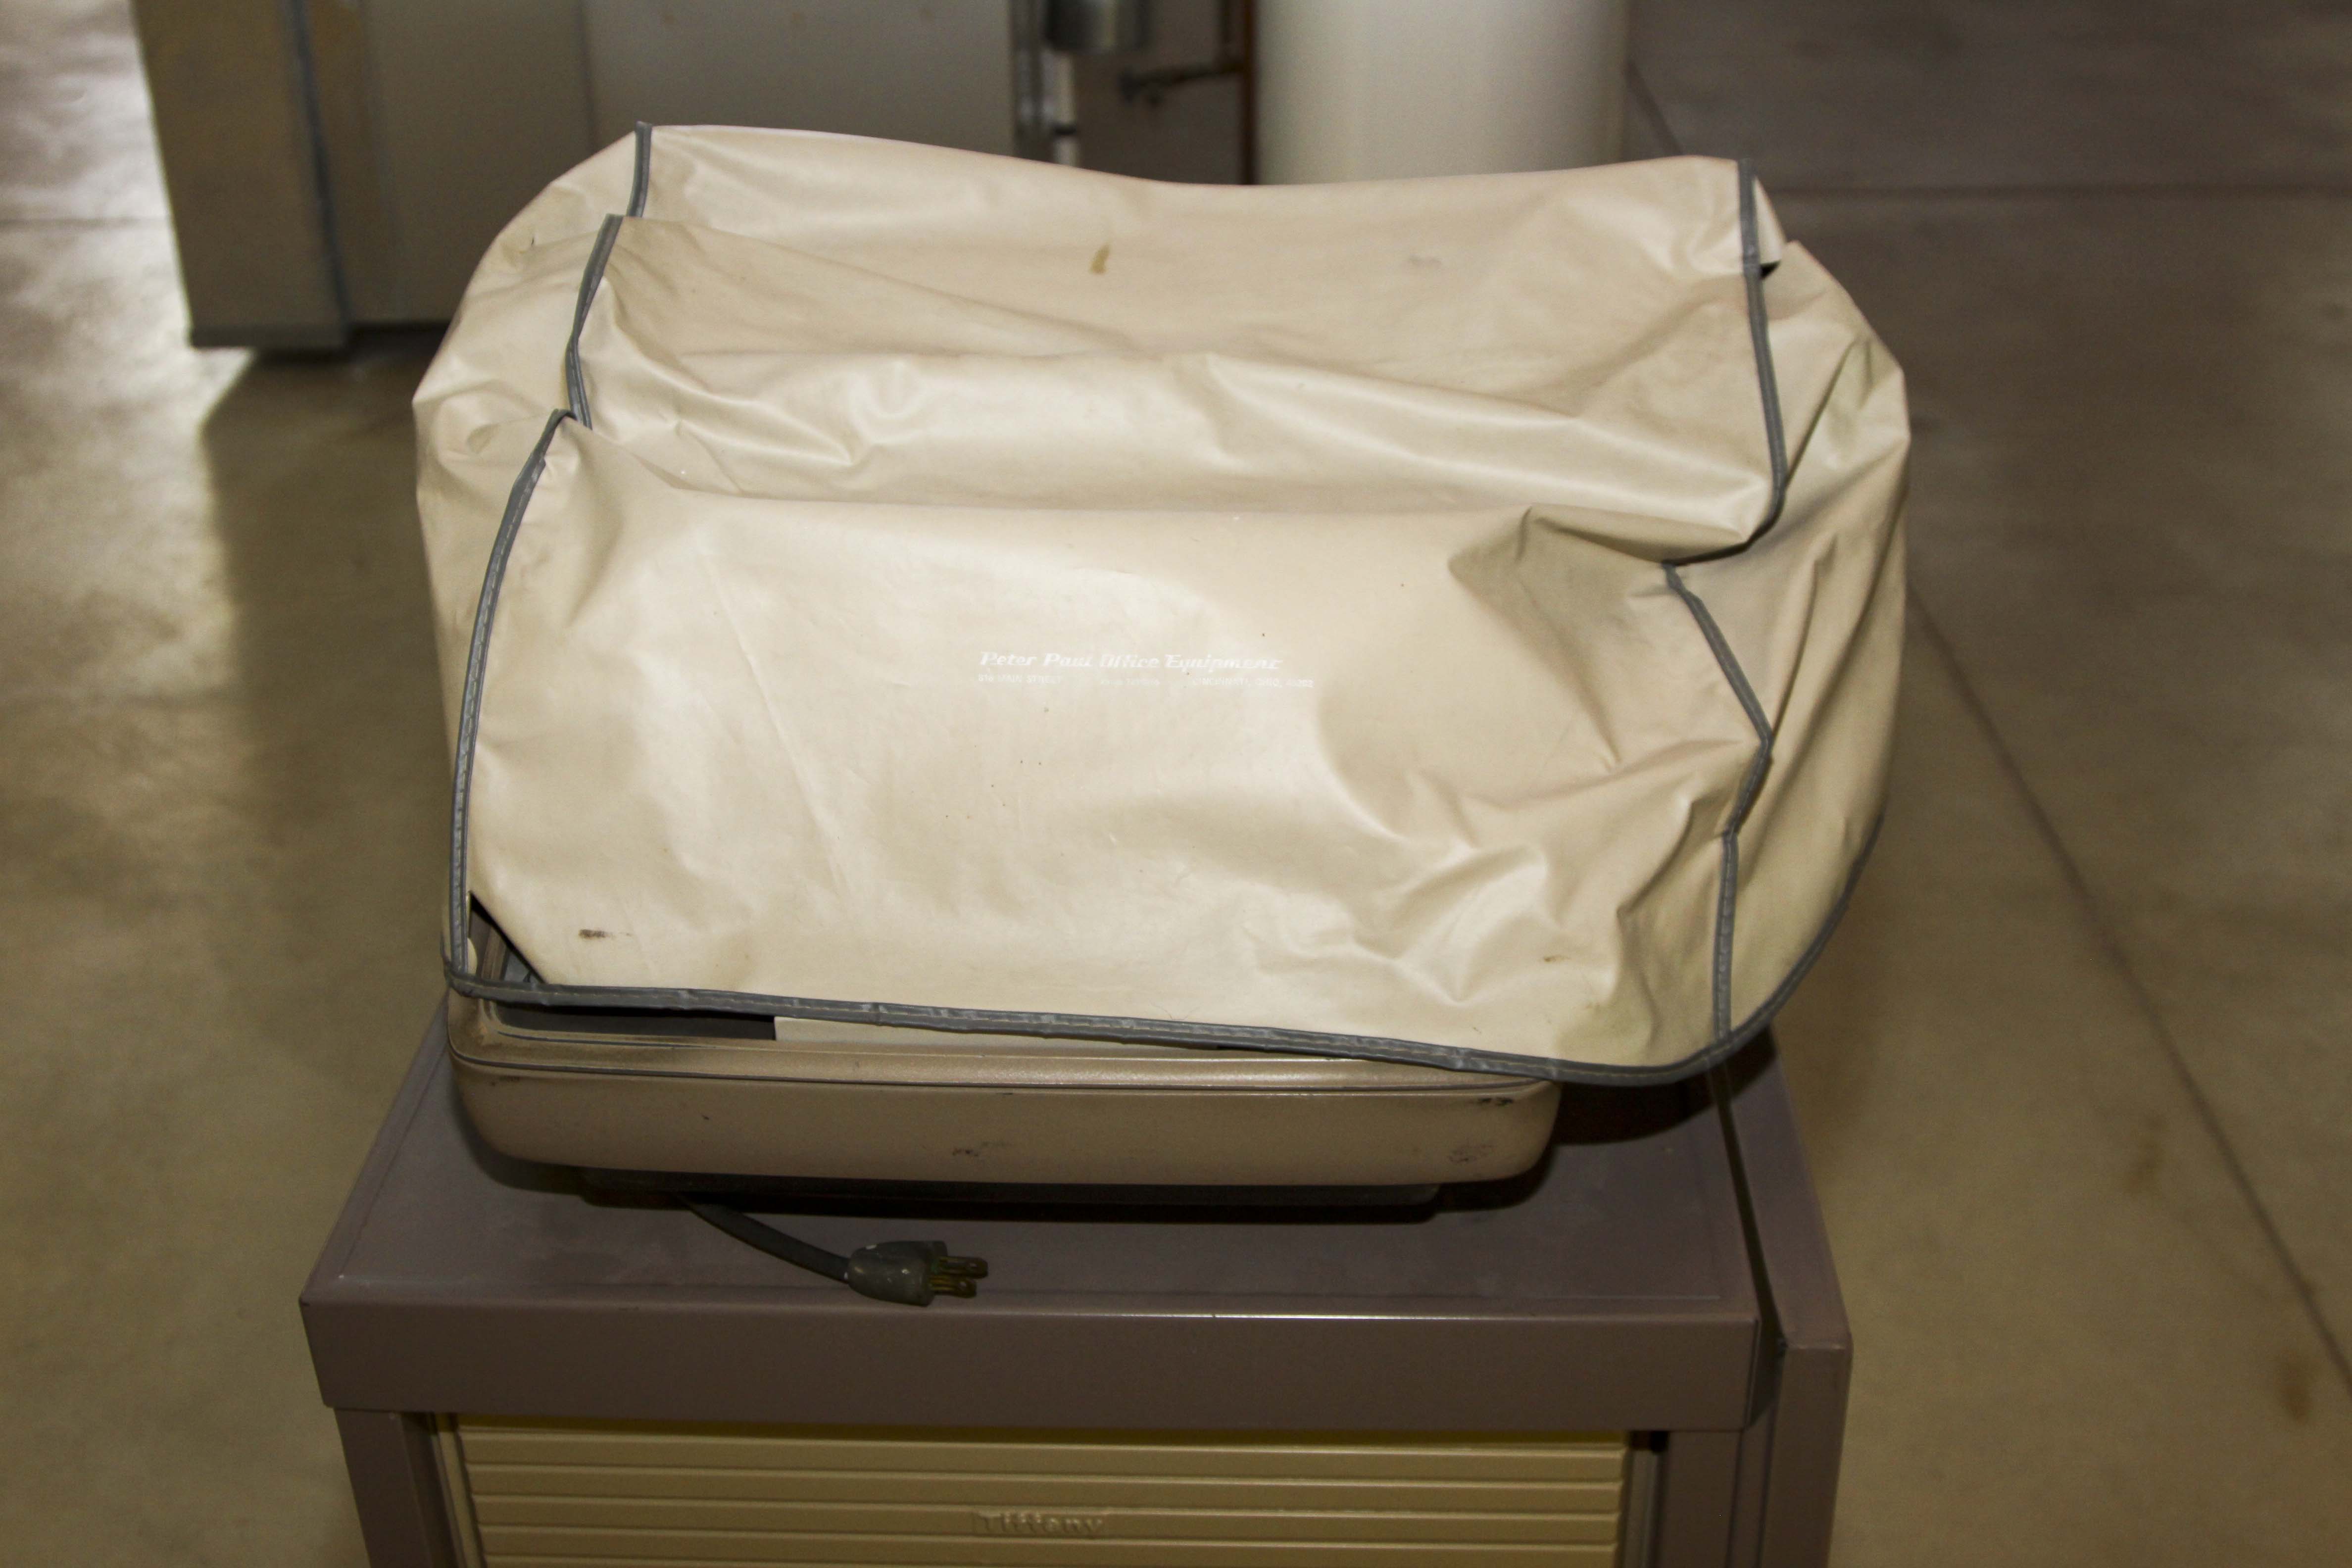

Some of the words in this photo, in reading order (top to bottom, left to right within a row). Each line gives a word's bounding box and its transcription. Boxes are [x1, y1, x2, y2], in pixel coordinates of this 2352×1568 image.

[980, 651, 1037, 666] Peter
[1042, 652, 1093, 668] Paul
[1100, 653, 1160, 669] Office
[1164, 653, 1283, 673] Equipment
[976, 1511, 1104, 1536] Tiffany
